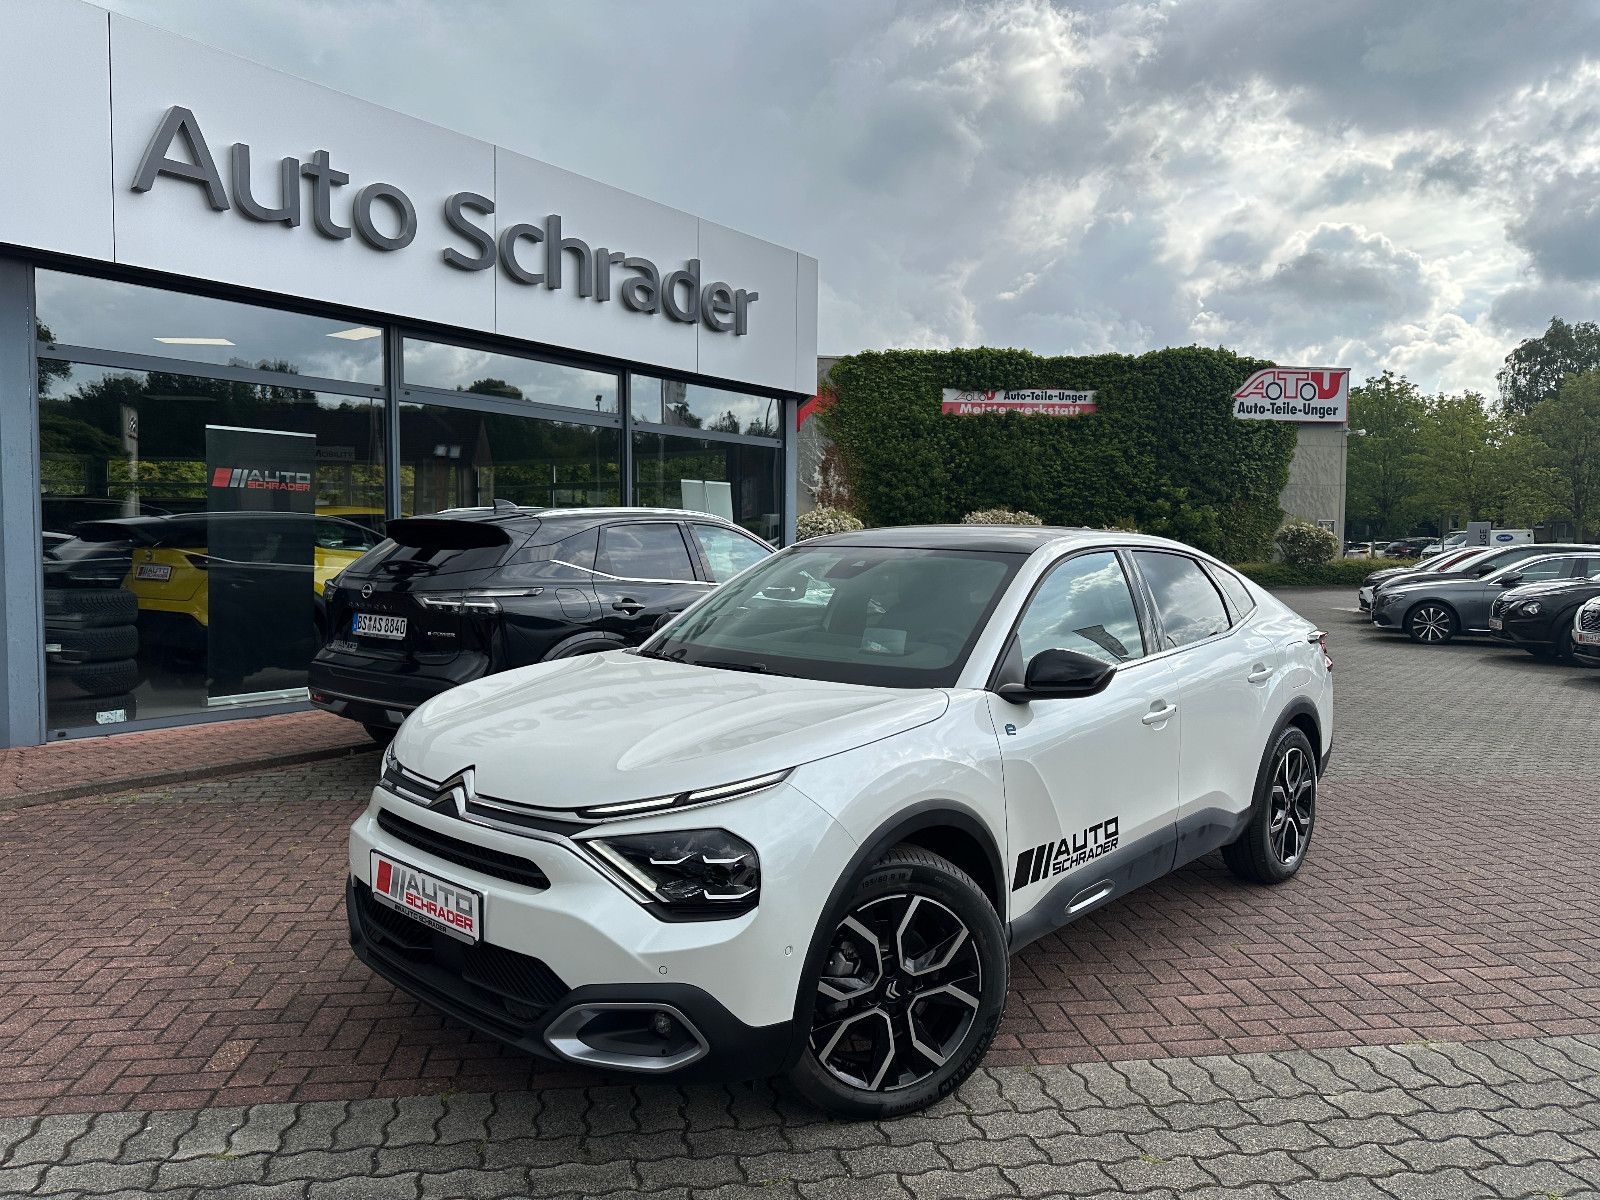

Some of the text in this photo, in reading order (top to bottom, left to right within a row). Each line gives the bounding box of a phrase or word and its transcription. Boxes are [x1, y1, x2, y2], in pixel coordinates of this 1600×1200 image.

[131, 105, 760, 335] Auto Schrader
[1004, 391, 1088, 403] Auto-Teile-Unger
[959, 403, 1081, 415] Meistewerkstatt
[1237, 402, 1339, 418] Auto-Teile-Unger
[248, 469, 311, 483] AUTO
[247, 481, 311, 491] SCHRADER
[357, 615, 406, 634] BS AS 8840
[1053, 816, 1119, 861] AUTO
[1053, 837, 1119, 876] SCHRADER
[406, 874, 473, 917] AUTO
[400, 908, 418, 920] AUTO
[405, 892, 474, 932] SCHRADER
